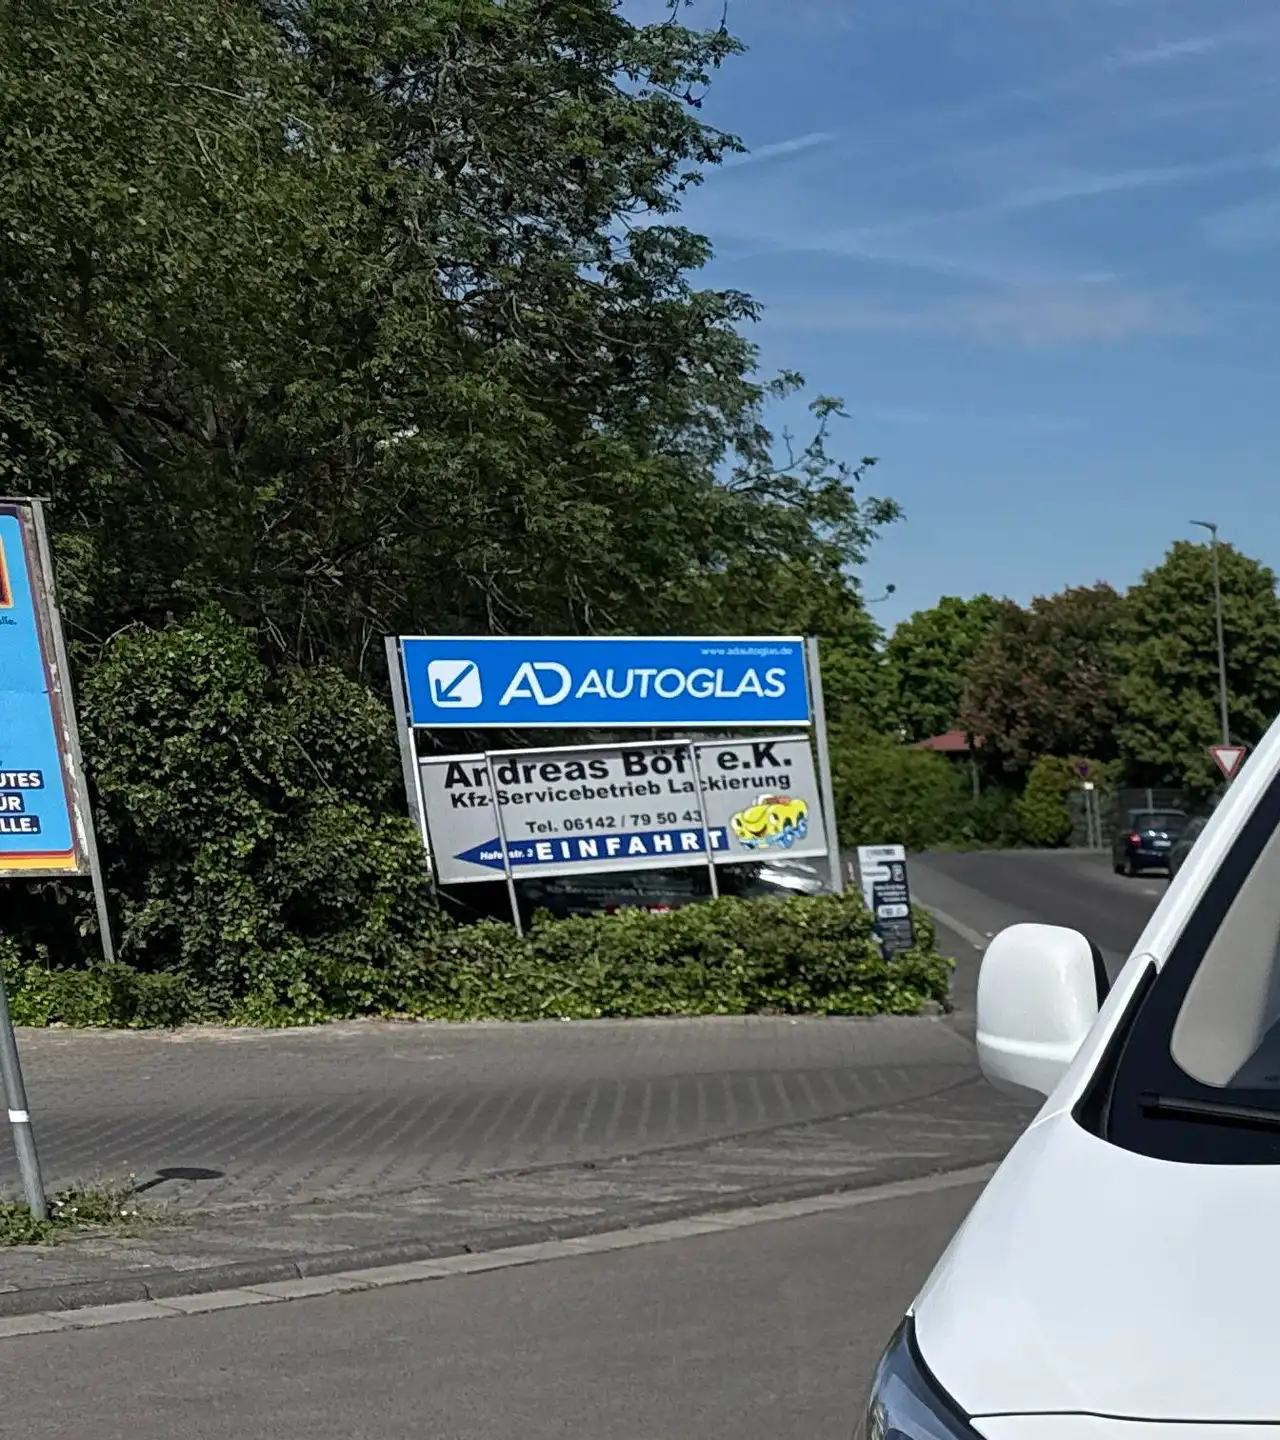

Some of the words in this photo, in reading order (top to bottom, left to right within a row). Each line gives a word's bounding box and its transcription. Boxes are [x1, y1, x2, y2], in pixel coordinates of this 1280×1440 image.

[498, 661, 572, 707] AD
[574, 667, 787, 699] AUTOGLAS
[443, 758, 609, 788] Andreas
[450, 780, 661, 809] Kfz-Servicebetrieb
[667, 773, 791, 794] Lackierung
[525, 820, 558, 834] Tel.
[563, 815, 616, 831] 06142
[629, 813, 652, 827] 79
[656, 811, 678, 825] 50
[681, 809, 703, 823] 43
[535, 830, 722, 861] EINFAHRT
